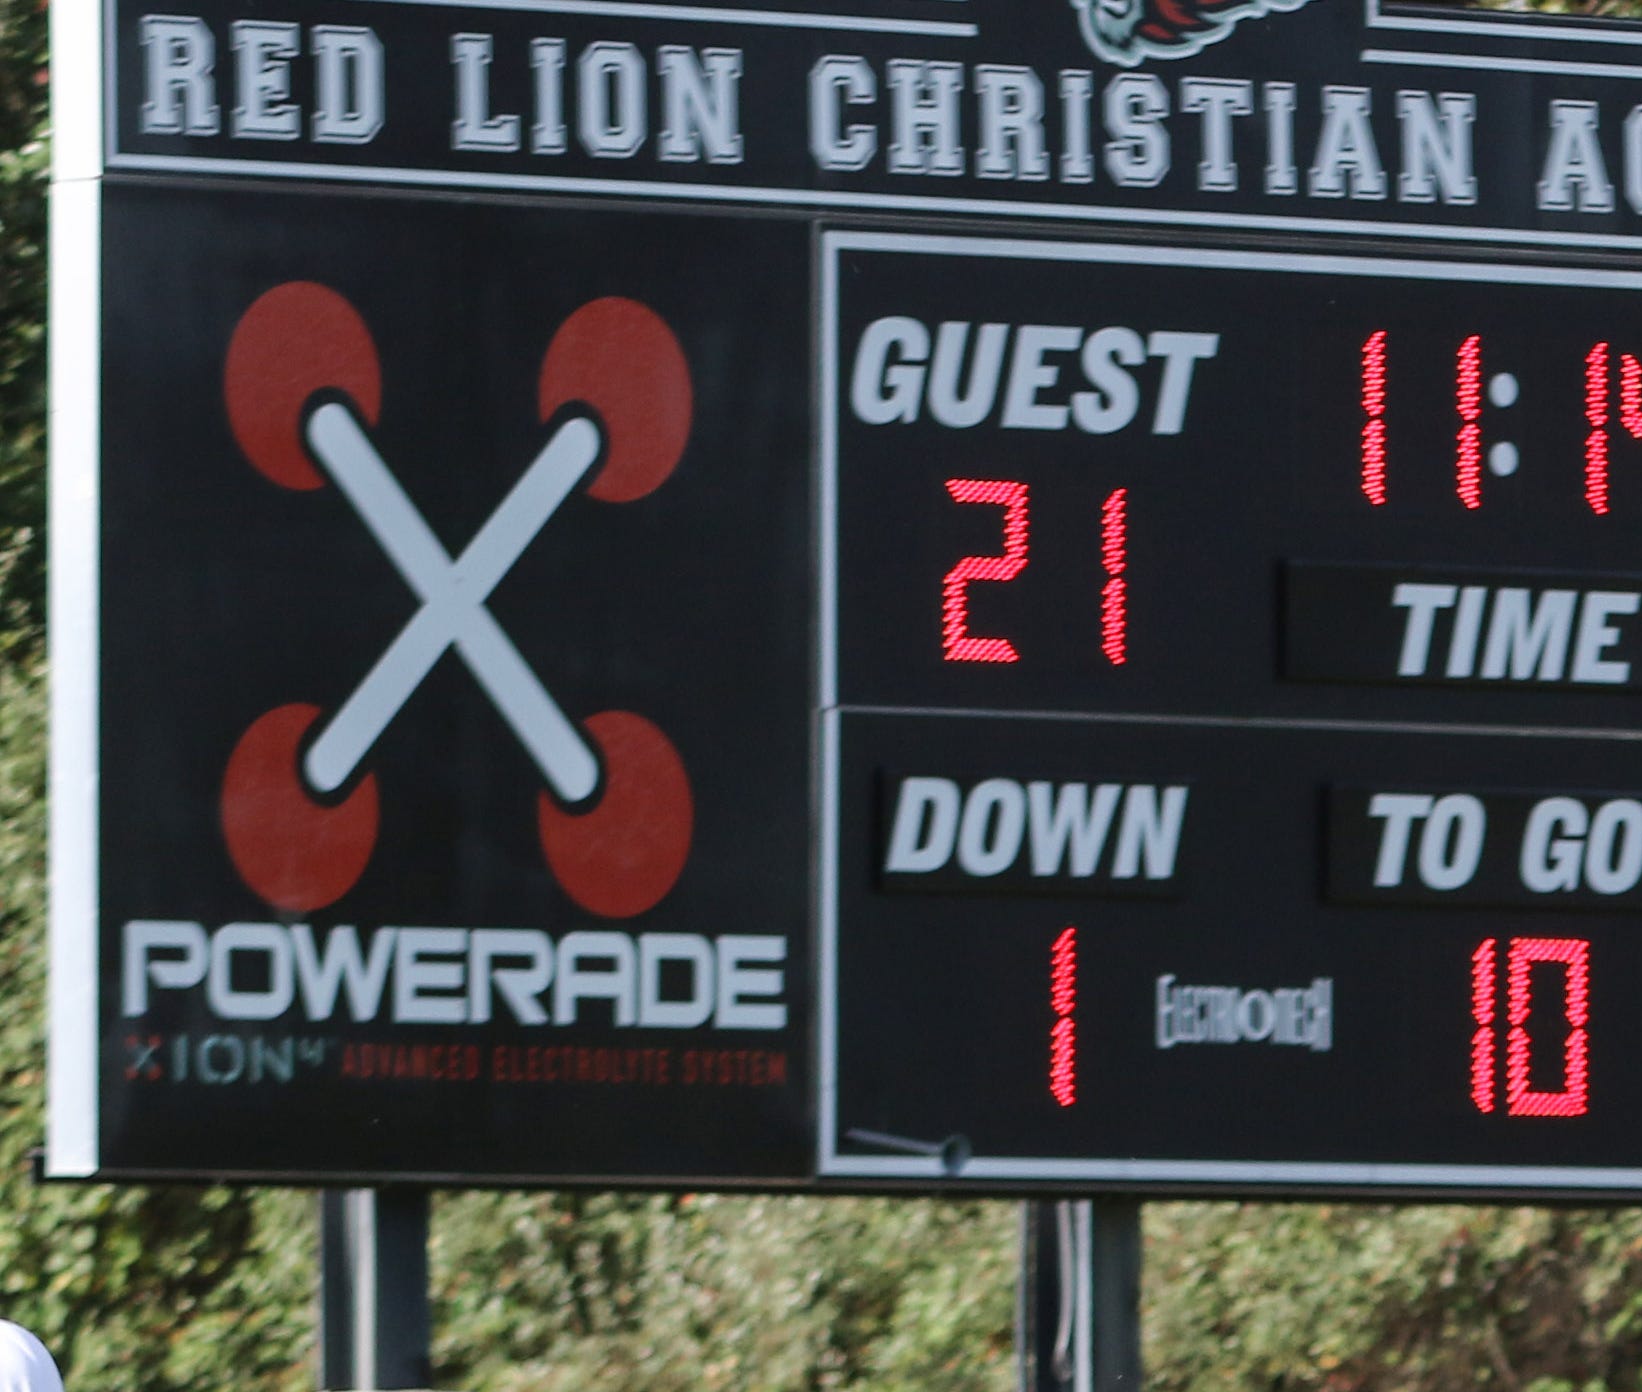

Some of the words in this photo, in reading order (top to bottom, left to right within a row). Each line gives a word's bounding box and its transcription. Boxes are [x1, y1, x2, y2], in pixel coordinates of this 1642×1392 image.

[140, 13, 385, 145] RED
[451, 32, 744, 166] LION
[809, 52, 1477, 205] CHRISTIAN
[851, 315, 1219, 435] GUEST
[940, 477, 1129, 666] 21
[1391, 582, 1640, 683] TIME
[886, 777, 1187, 879] DOWN
[1368, 793, 1485, 890] TO
[122, 919, 787, 1030] POWERADE
[1048, 926, 1079, 1108] 1
[1469, 935, 1592, 1119] 10
[340, 1043, 479, 1081] ADVANCED
[491, 1045, 670, 1085] ELECTROLYTE
[682, 1048, 787, 1086] SYSTEM
